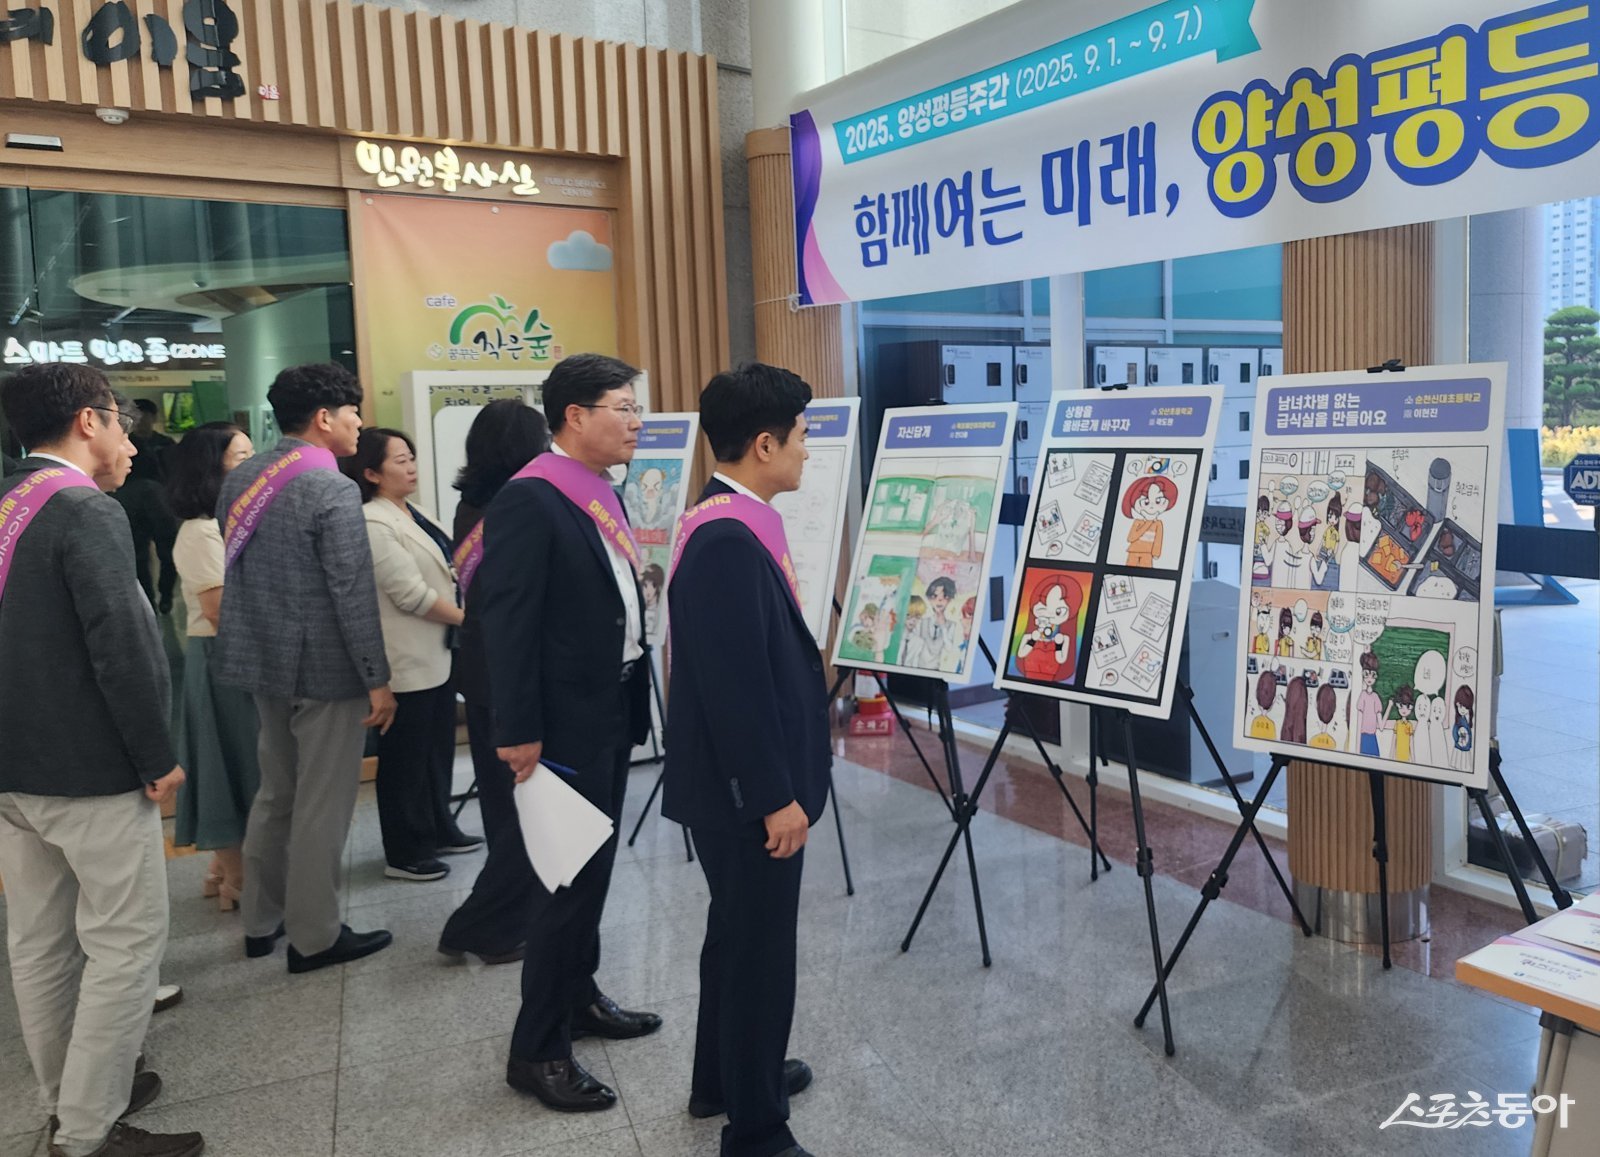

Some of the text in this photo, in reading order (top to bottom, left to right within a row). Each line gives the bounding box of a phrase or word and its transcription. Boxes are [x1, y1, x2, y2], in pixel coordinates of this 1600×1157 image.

[845, 114, 894, 155] 2025.
[897, 76, 1010, 140] 양성평등주간
[853, 3, 1600, 269] 함께여는 미래, 양성평등
[356, 140, 540, 195] 민원봉사실
[426, 295, 456, 307] cafe
[4, 336, 88, 364] 스마트
[88, 337, 144, 365] 민원
[1277, 393, 1361, 412] 남녀차별 없는
[1062, 417, 1131, 433] 올바르게 바꾸자
[1276, 410, 1388, 429] 급식실을 만들어요
[244, 486, 274, 527] 2025
